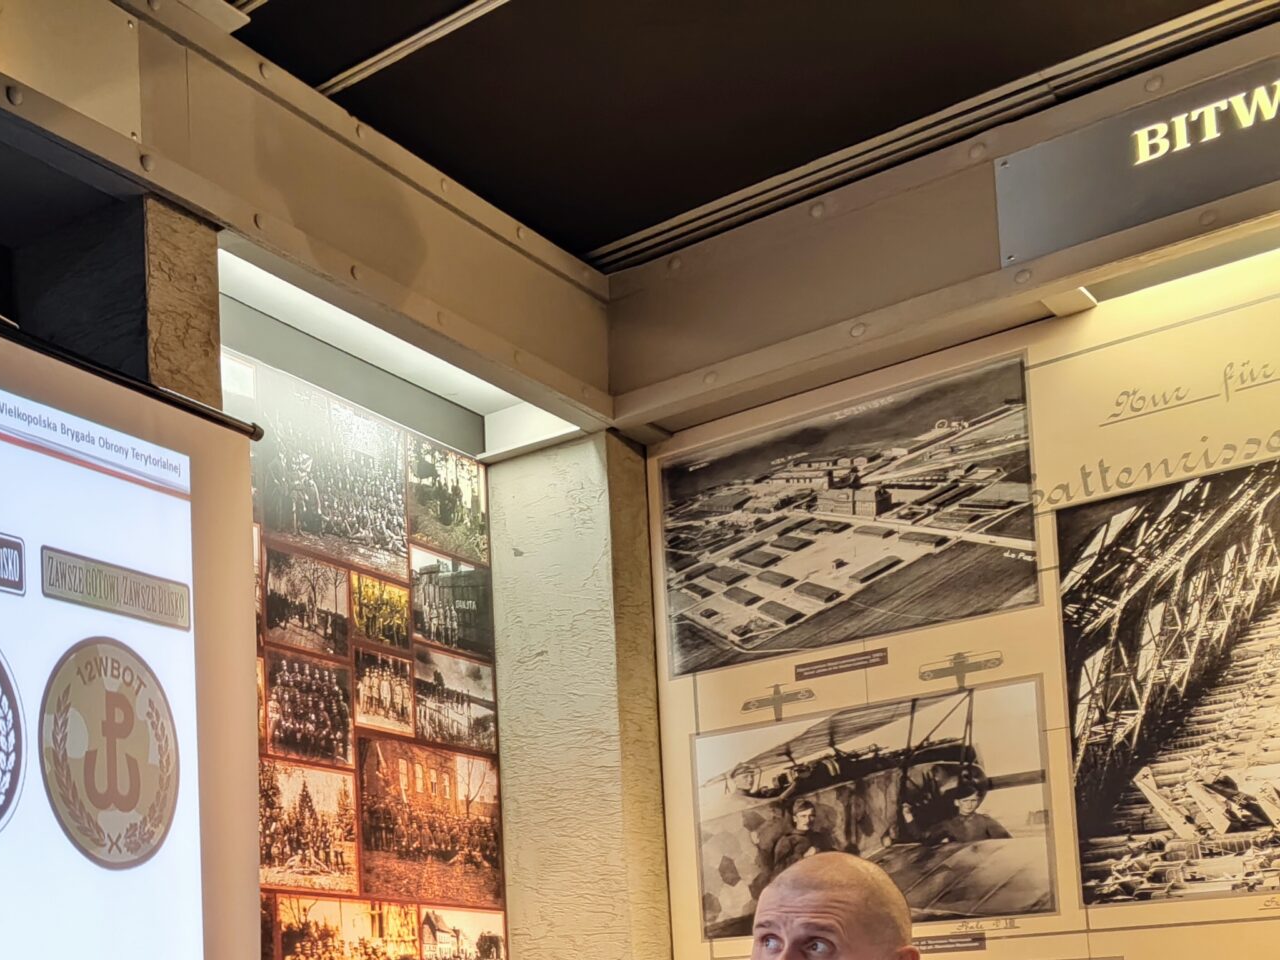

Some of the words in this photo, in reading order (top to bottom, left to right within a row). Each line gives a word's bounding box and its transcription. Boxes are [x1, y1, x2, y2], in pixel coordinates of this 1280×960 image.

[60, 422, 96, 446] Brygada
[98, 436, 129, 460] Obrony
[130, 446, 182, 478] Terytorialnej
[47, 555, 84, 594] ZAWSZE
[122, 576, 157, 613] ZAWSZE
[76, 655, 147, 696] 12WBOT
